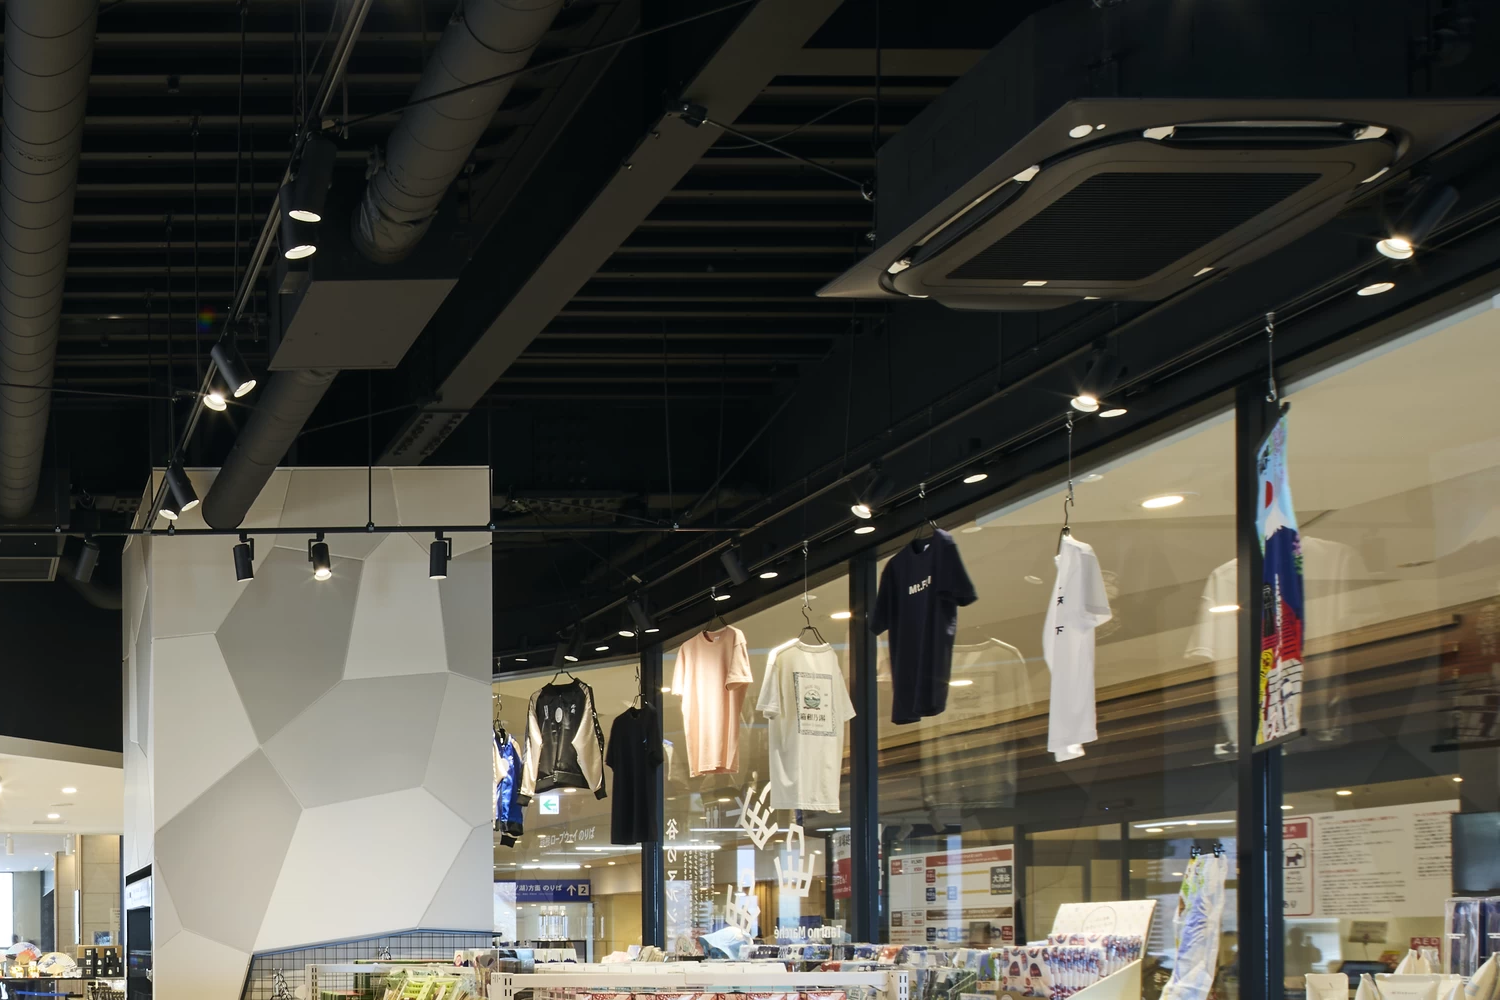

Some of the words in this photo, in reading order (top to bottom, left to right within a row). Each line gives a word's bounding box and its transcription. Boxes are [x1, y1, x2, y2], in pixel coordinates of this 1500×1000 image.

[578, 826, 596, 841] のりば
[542, 884, 562, 892] のりば
[1412, 938, 1440, 946] AED
